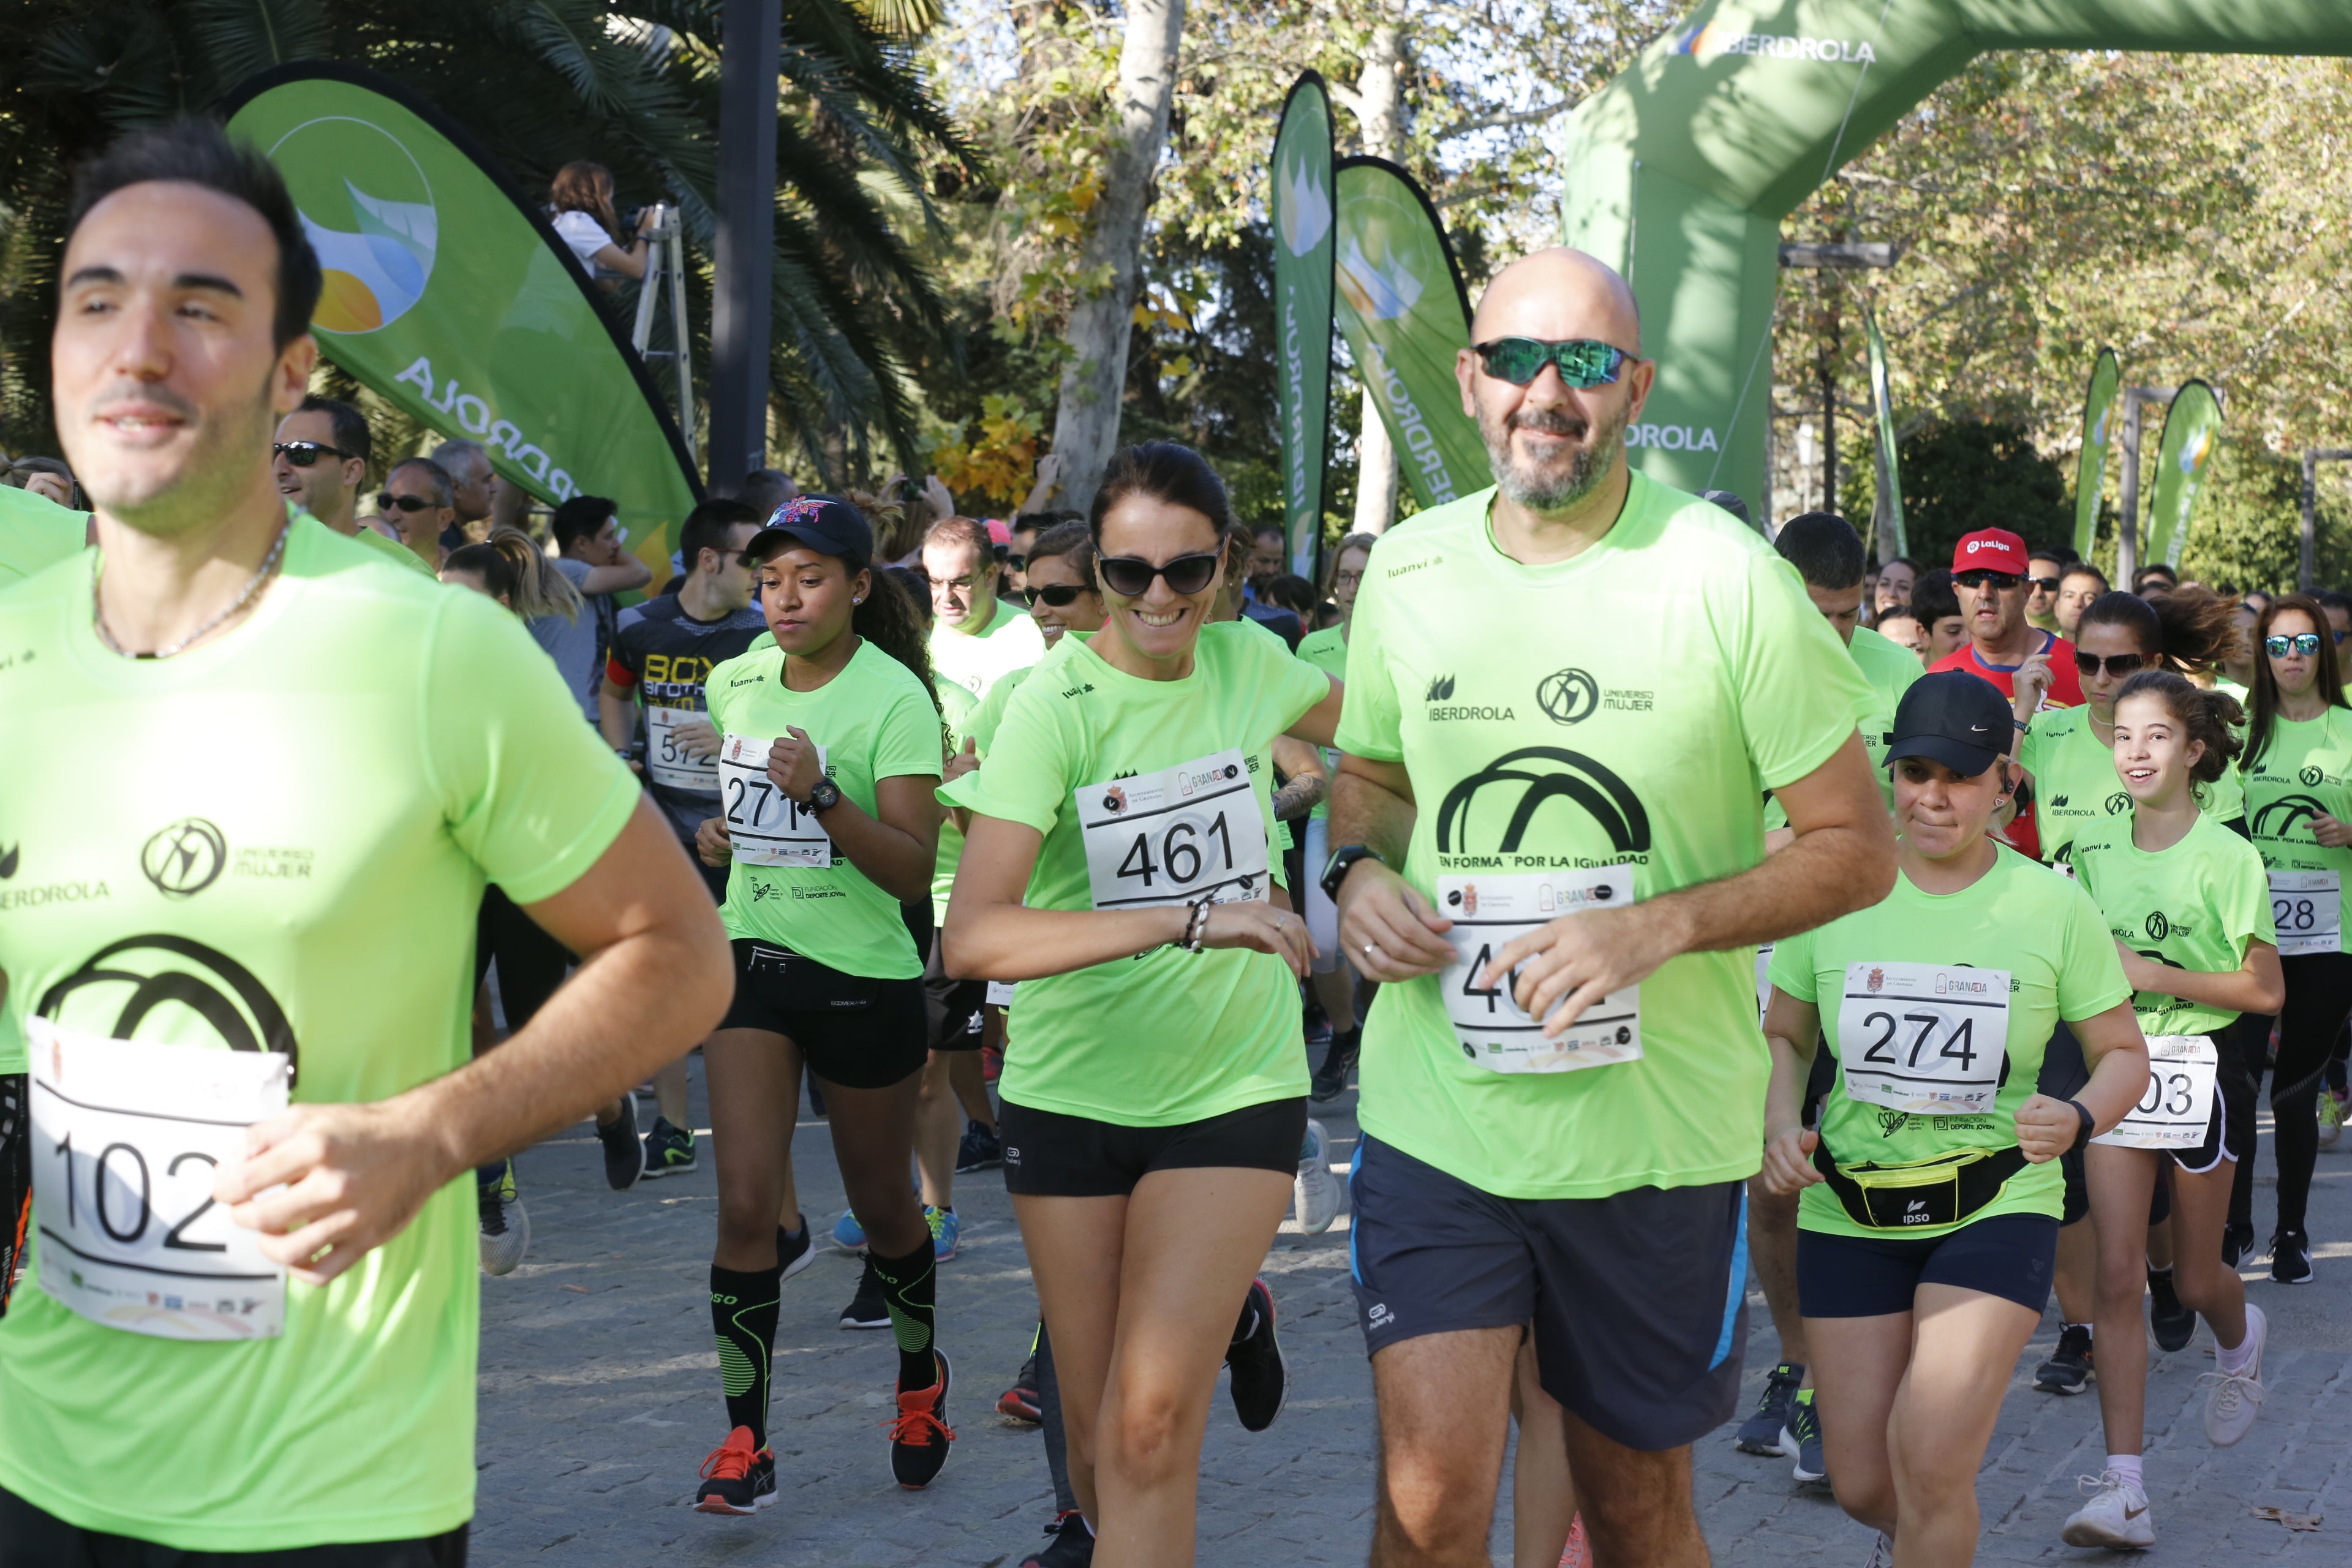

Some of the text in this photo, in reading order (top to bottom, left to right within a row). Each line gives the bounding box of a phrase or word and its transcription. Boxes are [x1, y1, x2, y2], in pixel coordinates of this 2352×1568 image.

[1981, 540, 2010, 551] LaLiga
[1388, 558, 1427, 578] luanvi
[731, 676, 756, 687] luanvi
[1604, 690, 1654, 699] UNIVERSO
[1604, 699, 1654, 711] MUJER
[1430, 707, 1515, 722] IBERDROLA
[728, 777, 797, 831] 271
[1117, 811, 1232, 886] 461
[1453, 857, 1503, 869] FORMA
[1550, 856, 1569, 867] LA
[2273, 900, 2315, 930] 28
[1948, 980, 1987, 993] GRANADA
[1863, 1011, 1977, 1071] 274
[56, 1131, 227, 1252] 102
